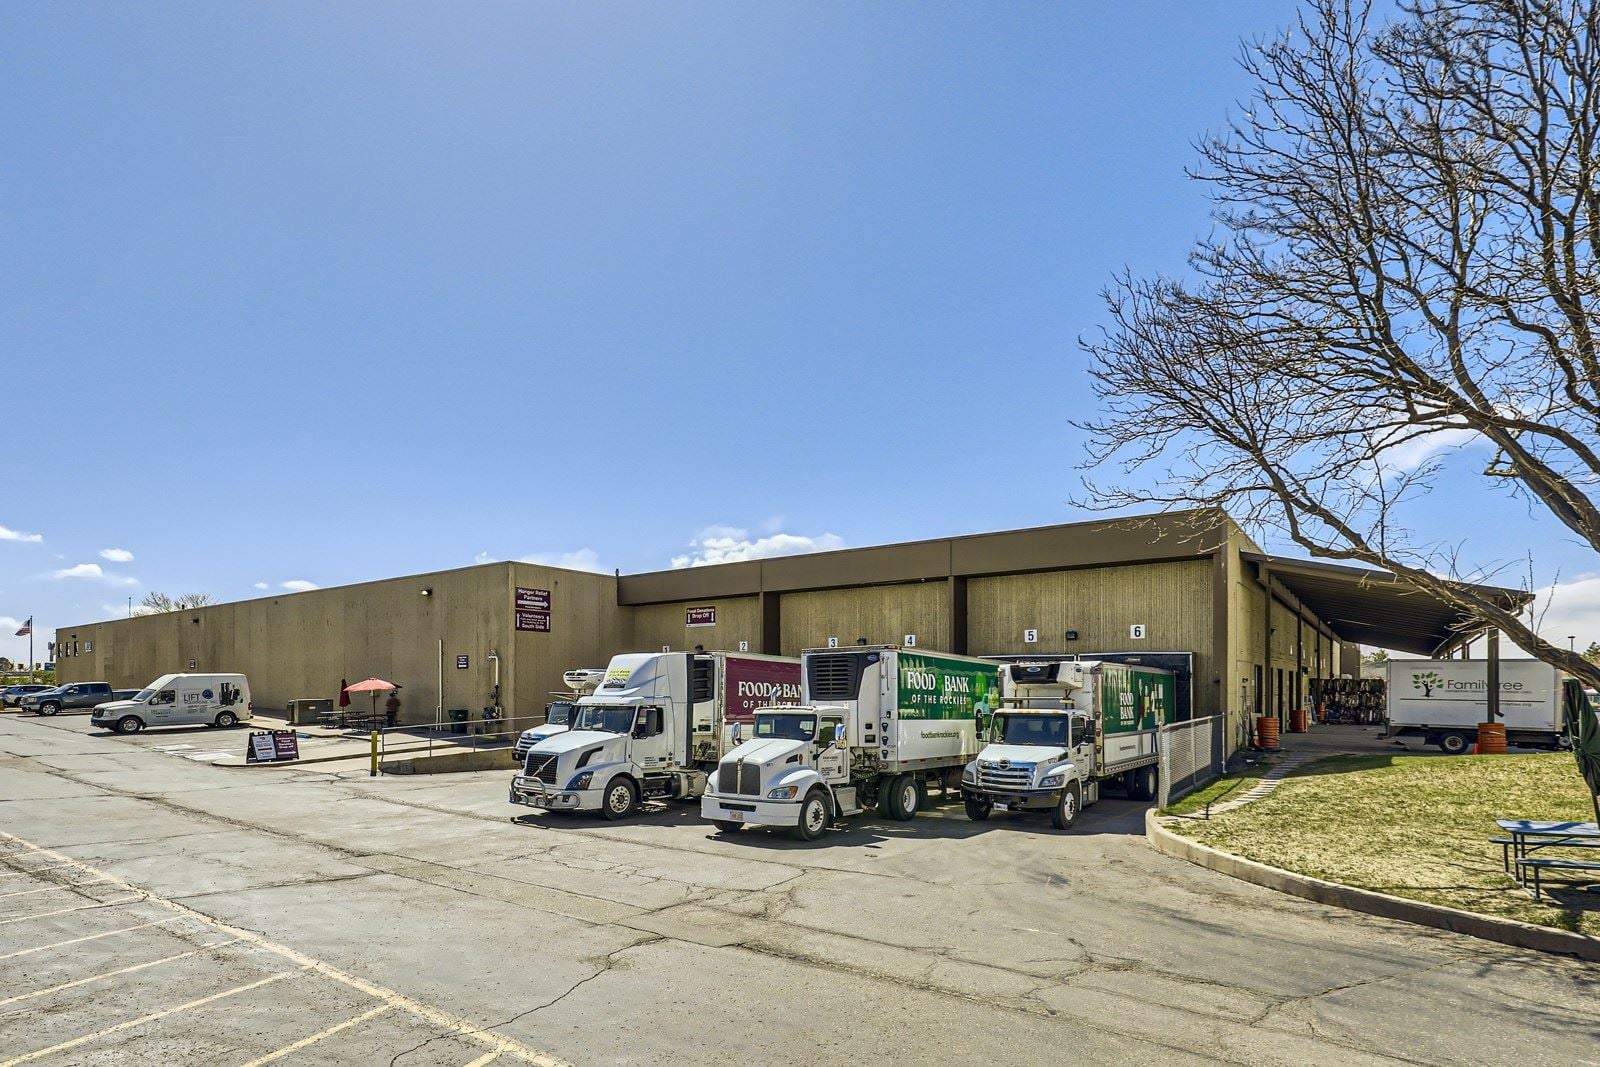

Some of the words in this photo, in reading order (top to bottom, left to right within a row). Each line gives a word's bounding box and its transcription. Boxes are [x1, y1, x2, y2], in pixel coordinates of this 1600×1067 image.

[1027, 630, 1034, 641] 5
[1134, 626, 1141, 637] 6
[830, 638, 836, 648] 3
[907, 635, 913, 645] 4
[741, 642, 746, 651] 2
[907, 671, 936, 690] FOOD
[944, 675, 970, 693] BANK
[738, 681, 772, 697] FOOD
[183, 693, 200, 701] LIFT
[911, 694, 921, 703] OF
[924, 695, 937, 704] THE
[939, 696, 967, 705] ROCKIES
[1119, 692, 1134, 706] FOOD
[742, 700, 755, 708] OF
[1120, 706, 1135, 720] BANK
[921, 731, 960, 739] foodbankrockies.org
